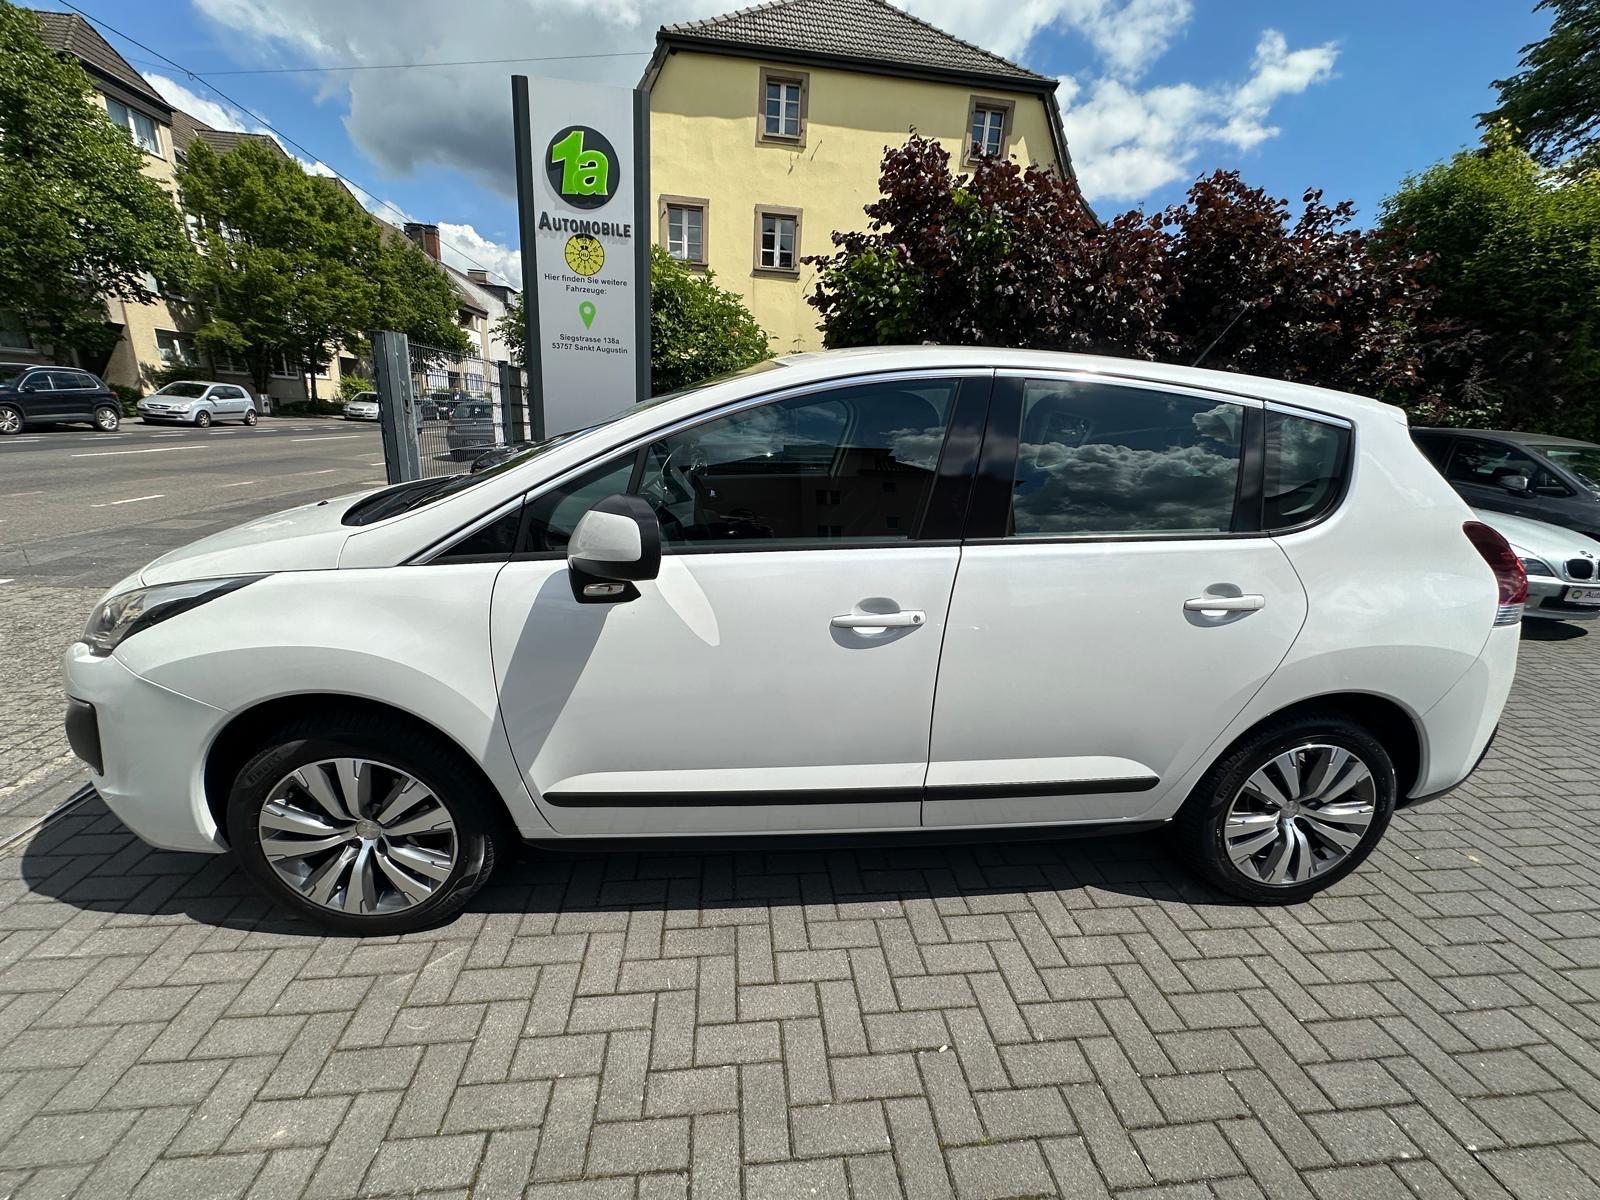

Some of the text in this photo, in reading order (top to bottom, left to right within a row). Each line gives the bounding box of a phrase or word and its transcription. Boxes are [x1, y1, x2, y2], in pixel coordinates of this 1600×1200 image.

[551, 131, 608, 195] 1a
[539, 211, 631, 237] AUTOMOBILE
[544, 273, 628, 287] Hier finden Sie weitere
[565, 285, 607, 295] Fahrzeuge:
[559, 333, 620, 345] Siegstrasse 138a
[551, 342, 628, 355] 53757 Sankt Augustin
